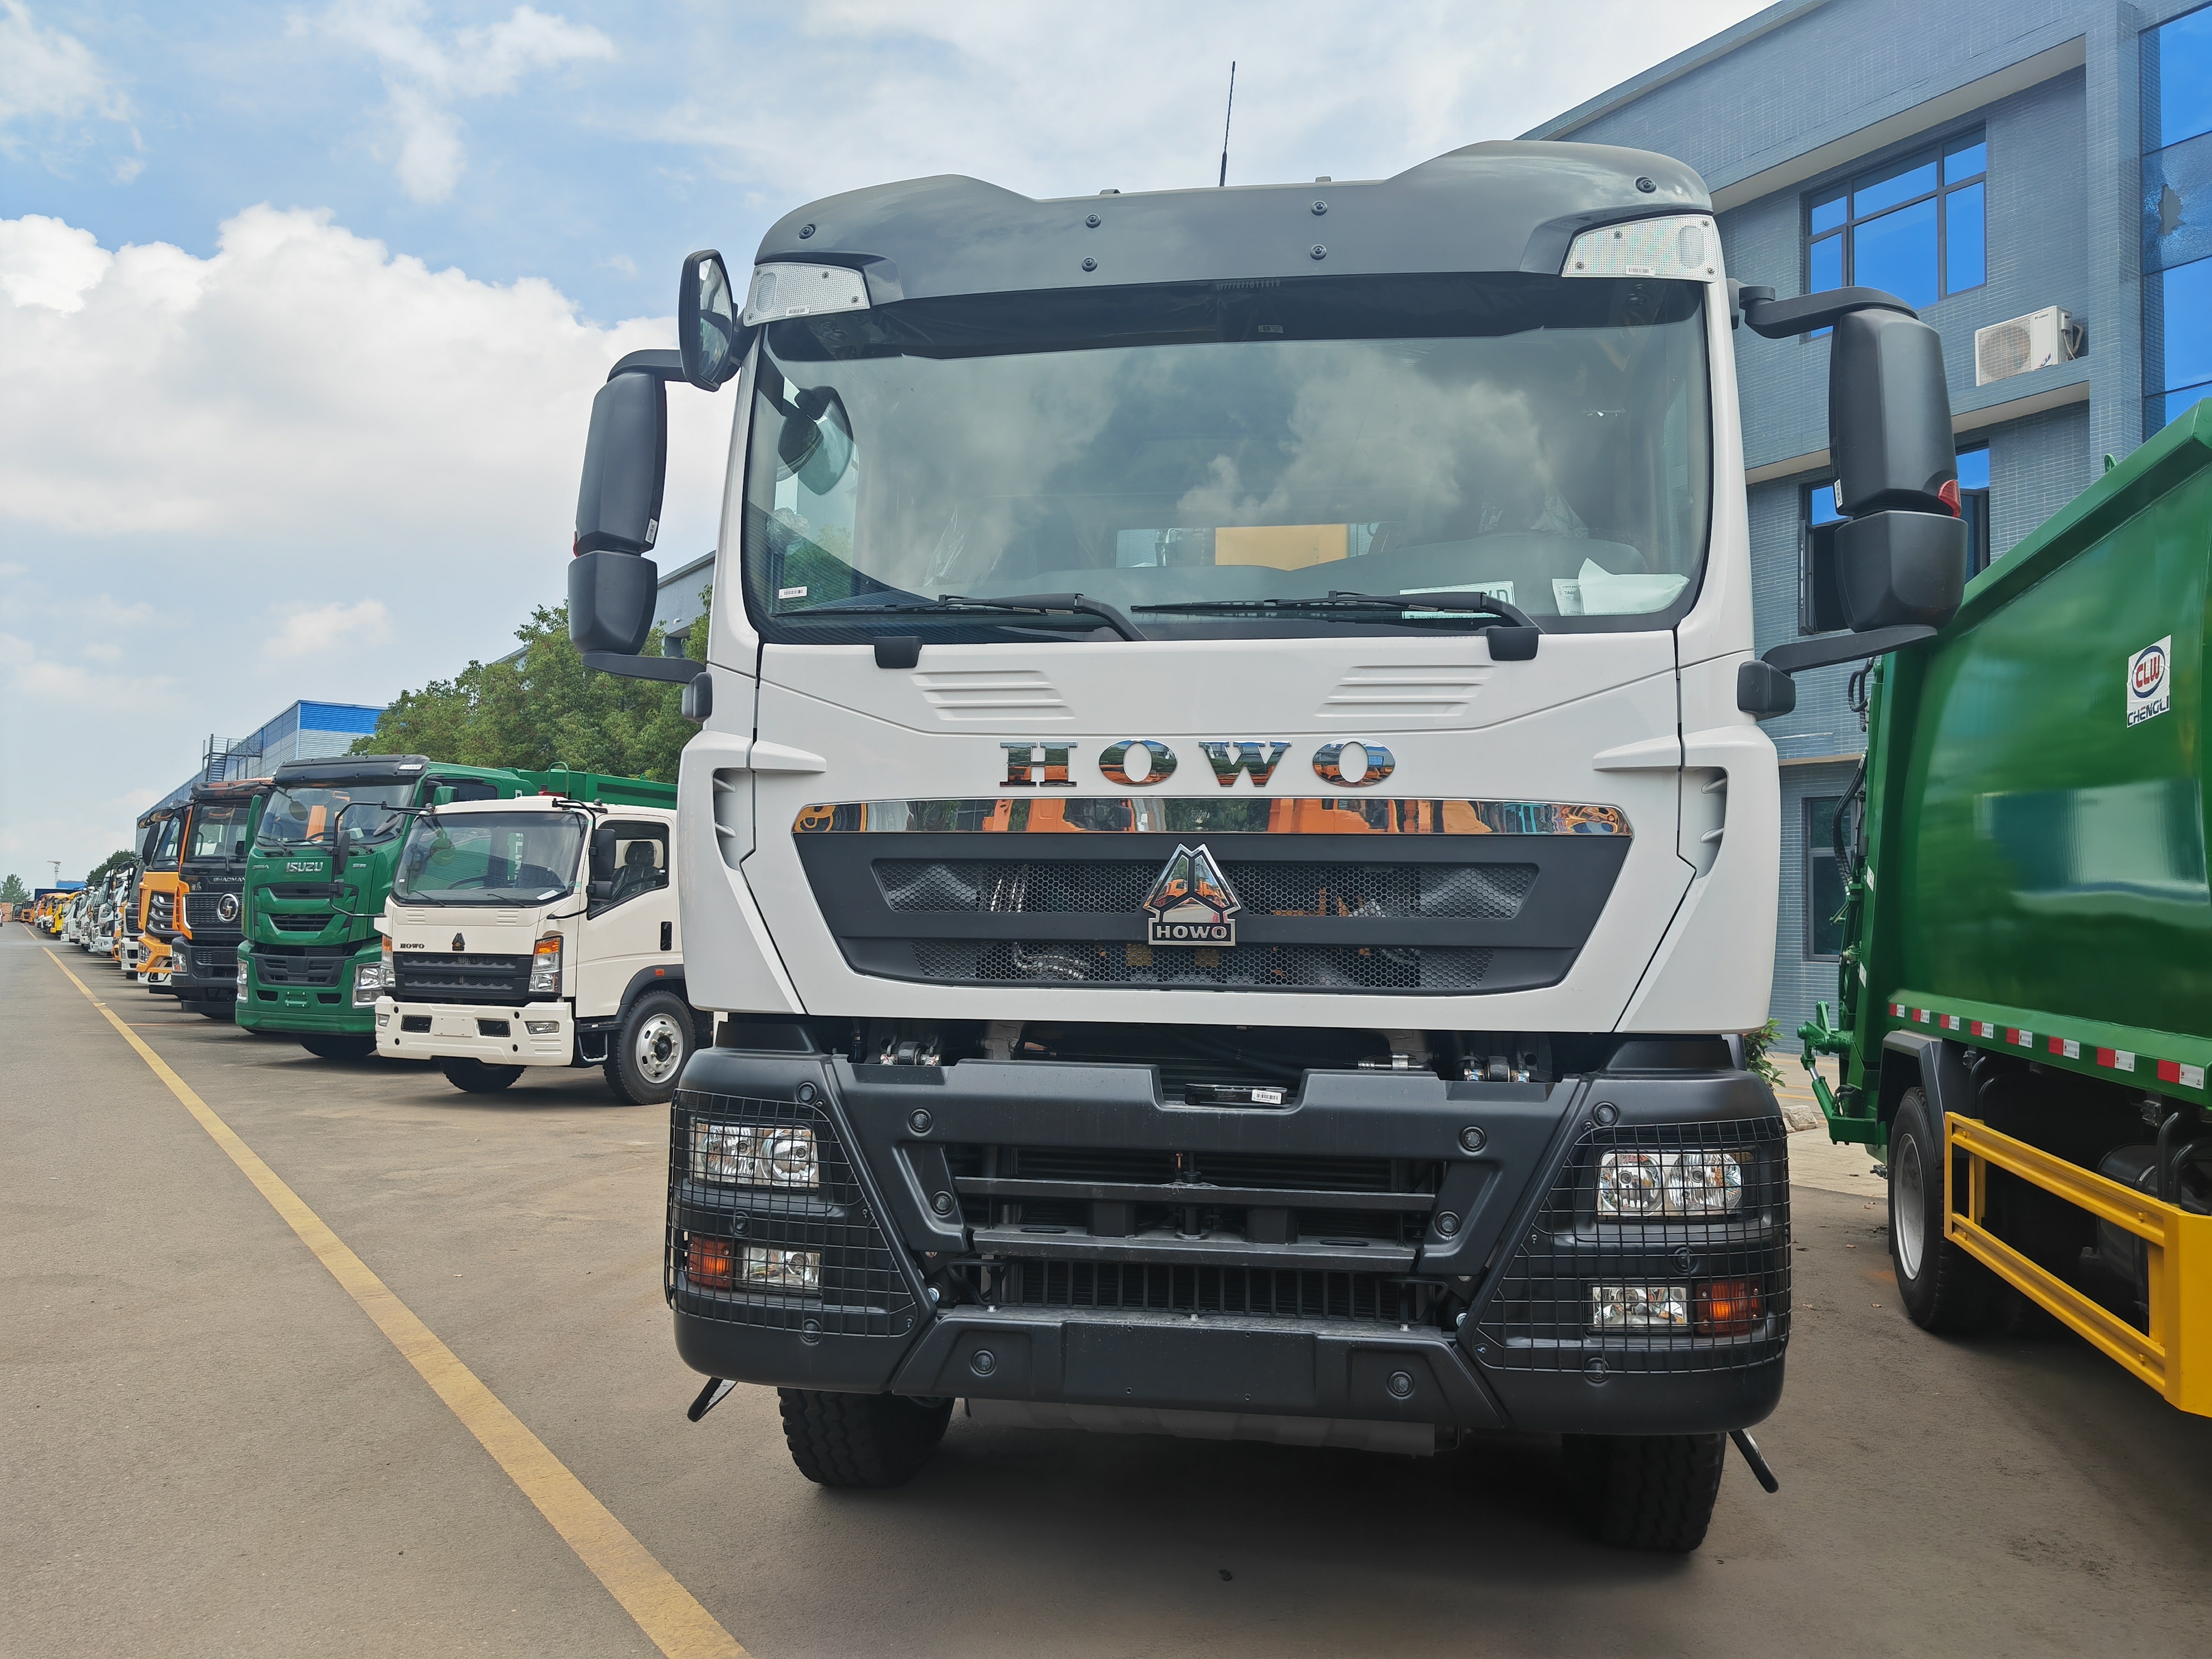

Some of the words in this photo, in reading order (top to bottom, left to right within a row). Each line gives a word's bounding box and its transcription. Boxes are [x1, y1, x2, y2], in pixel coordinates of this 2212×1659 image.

[2136, 655, 2160, 688] CLW
[2127, 696, 2169, 726] CHENGLI
[1000, 738, 1396, 787] HOWO
[286, 862, 323, 873] ISUZU
[1156, 926, 1227, 939] HOWO
